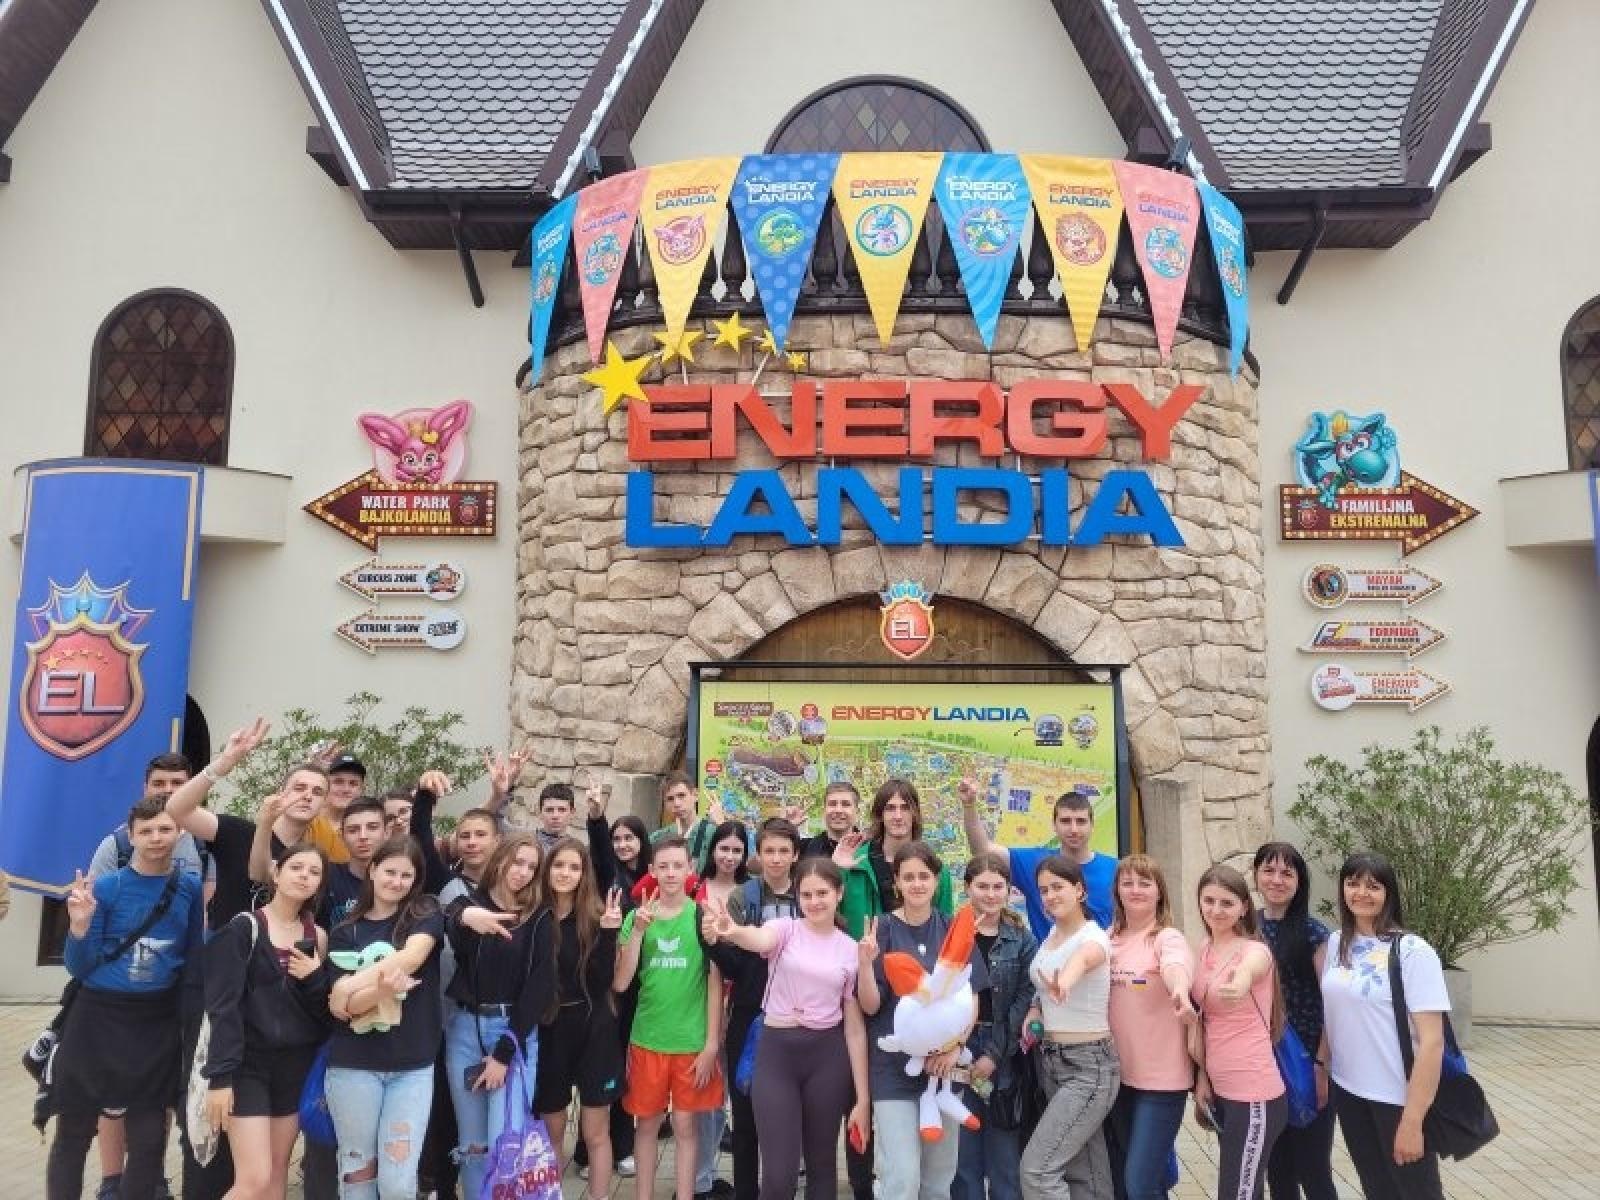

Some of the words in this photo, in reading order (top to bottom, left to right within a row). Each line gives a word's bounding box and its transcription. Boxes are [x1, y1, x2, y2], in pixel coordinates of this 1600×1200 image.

[850, 187, 917, 198] LANDIA
[950, 182, 1018, 191] ENERGY
[656, 195, 717, 210] LANDIA
[748, 192, 815, 202] LANDIA
[950, 191, 1016, 201] LANDIA
[1050, 195, 1112, 208] LANDIA
[627, 380, 1205, 462] ENERGY
[361, 495, 407, 509] WATER
[413, 495, 450, 509] PARK
[625, 467, 1187, 548] LANDIA
[1341, 500, 1414, 513] FAMILIJNA
[359, 509, 452, 523] BAJKOLANDIA
[1330, 513, 1428, 528] EKSTREMALNA
[891, 618, 927, 640] EL
[36, 670, 126, 716] EL
